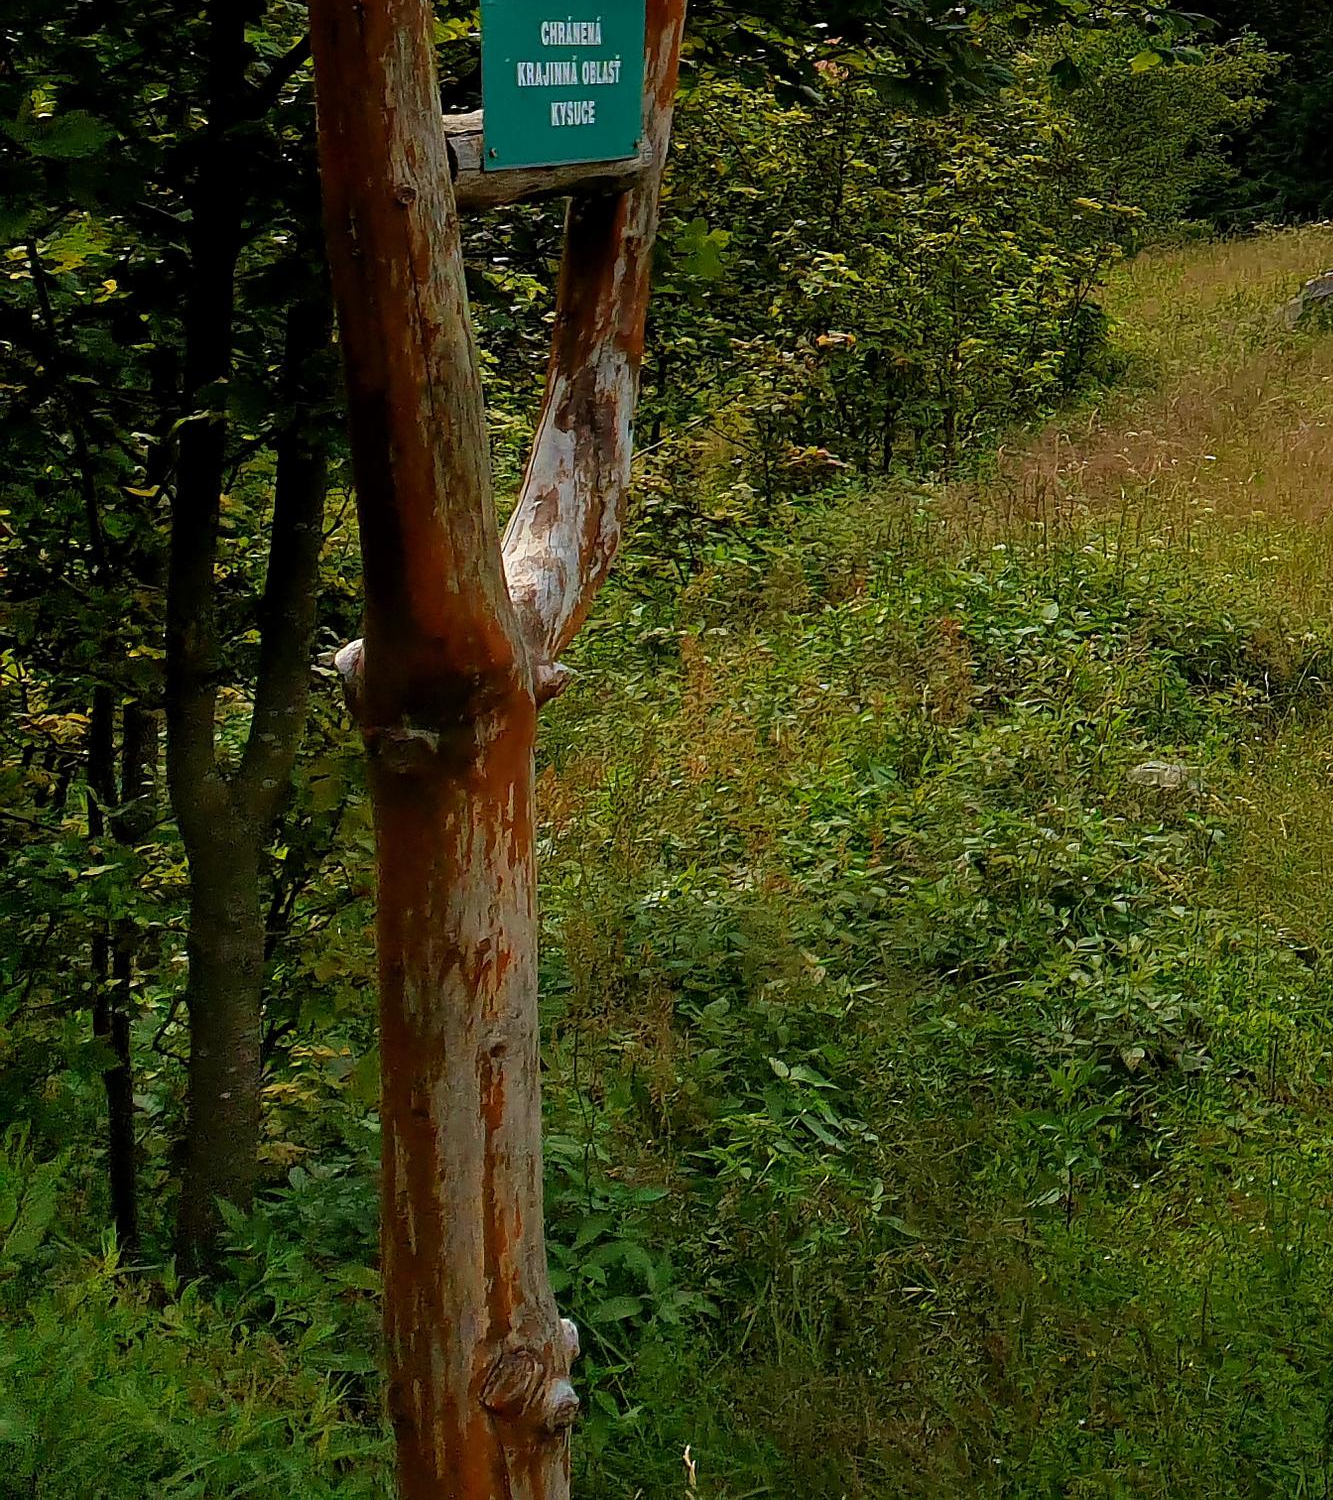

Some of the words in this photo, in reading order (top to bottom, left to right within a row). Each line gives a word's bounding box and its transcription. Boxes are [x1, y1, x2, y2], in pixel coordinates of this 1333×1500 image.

[541, 16, 602, 45] CHRÁNENÁ
[517, 55, 579, 86] KRAJINNÁ
[582, 54, 621, 84] OBLASŤ
[551, 100, 596, 126] KYSUCE
